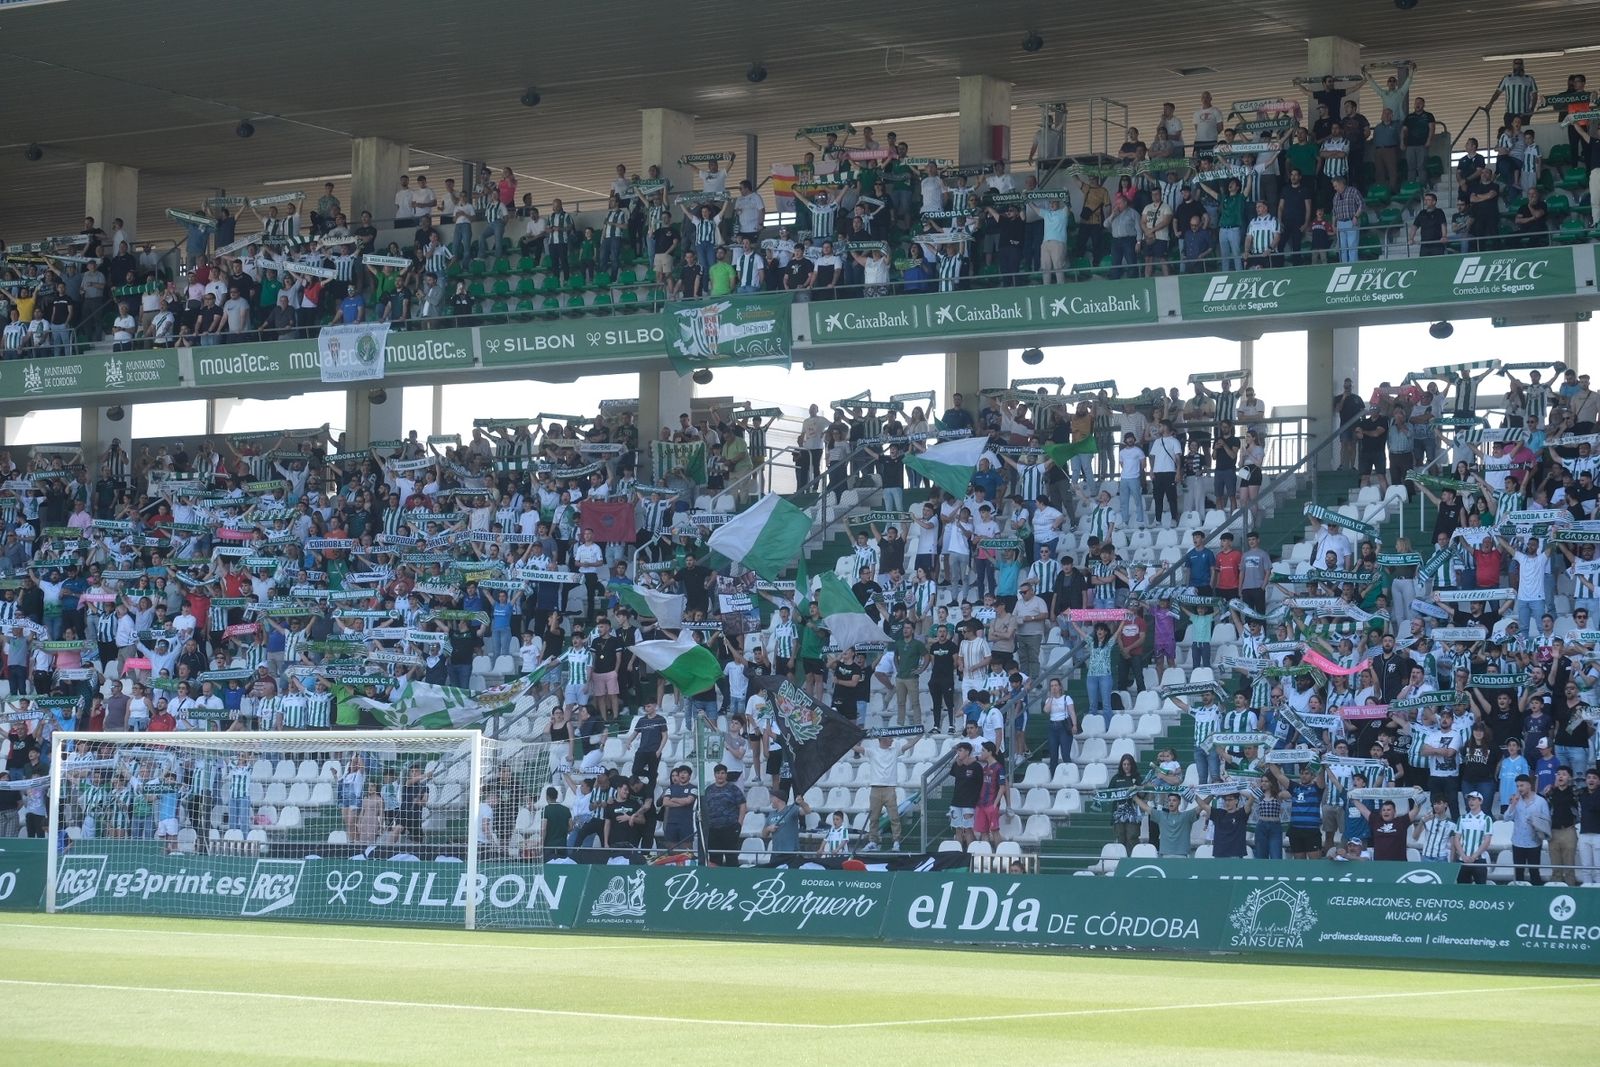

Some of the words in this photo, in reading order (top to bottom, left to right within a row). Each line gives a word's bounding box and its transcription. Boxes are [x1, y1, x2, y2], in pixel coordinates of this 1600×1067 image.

[1484, 260, 1548, 280] PACC
[1235, 278, 1290, 300] PACC
[1355, 270, 1417, 290] PACC
[1490, 284, 1501, 293] de
[1502, 282, 1536, 293] Seguros
[1070, 294, 1141, 314] CaixaBank
[1238, 303, 1247, 311] de
[1248, 300, 1278, 310] Seguros
[1361, 294, 1371, 302] de
[1372, 292, 1404, 302] Seguros
[844, 312, 909, 331] CaixaBank
[955, 303, 1023, 322] CaixaBank
[505, 334, 575, 351] SILBON
[605, 327, 664, 345] SILBO
[385, 536, 416, 545] CORDOB
[473, 532, 495, 542] FRENTE
[522, 571, 554, 580] CORDOBA
[58, 868, 97, 894] RG3
[104, 868, 246, 899] rg3print.es
[251, 873, 294, 900] RG3
[801, 878, 835, 888] BODEGA
[837, 880, 843, 889] Y
[845, 880, 882, 890] VIÑEDOS
[368, 871, 567, 910] SILBON
[663, 869, 740, 913] Pérez
[739, 871, 877, 931] Barquero
[1329, 896, 1413, 909] CELEBRACIONES,
[1415, 898, 1466, 910] EVENTOS,
[1469, 900, 1502, 911] BODAS
[1506, 901, 1514, 911] Y
[908, 881, 954, 929] el
[958, 882, 1041, 933] Día
[1047, 914, 1078, 935] DE
[1084, 911, 1200, 940] CÓRDOBA
[1385, 911, 1424, 922] MUCHO
[1426, 910, 1448, 922] MÁS
[1319, 931, 1422, 944] jardinesdesansueña.com
[1432, 934, 1510, 947] cillerocatering.es
[1515, 923, 1600, 941] CILLERO
[1230, 934, 1304, 949] SANSUEÑA
